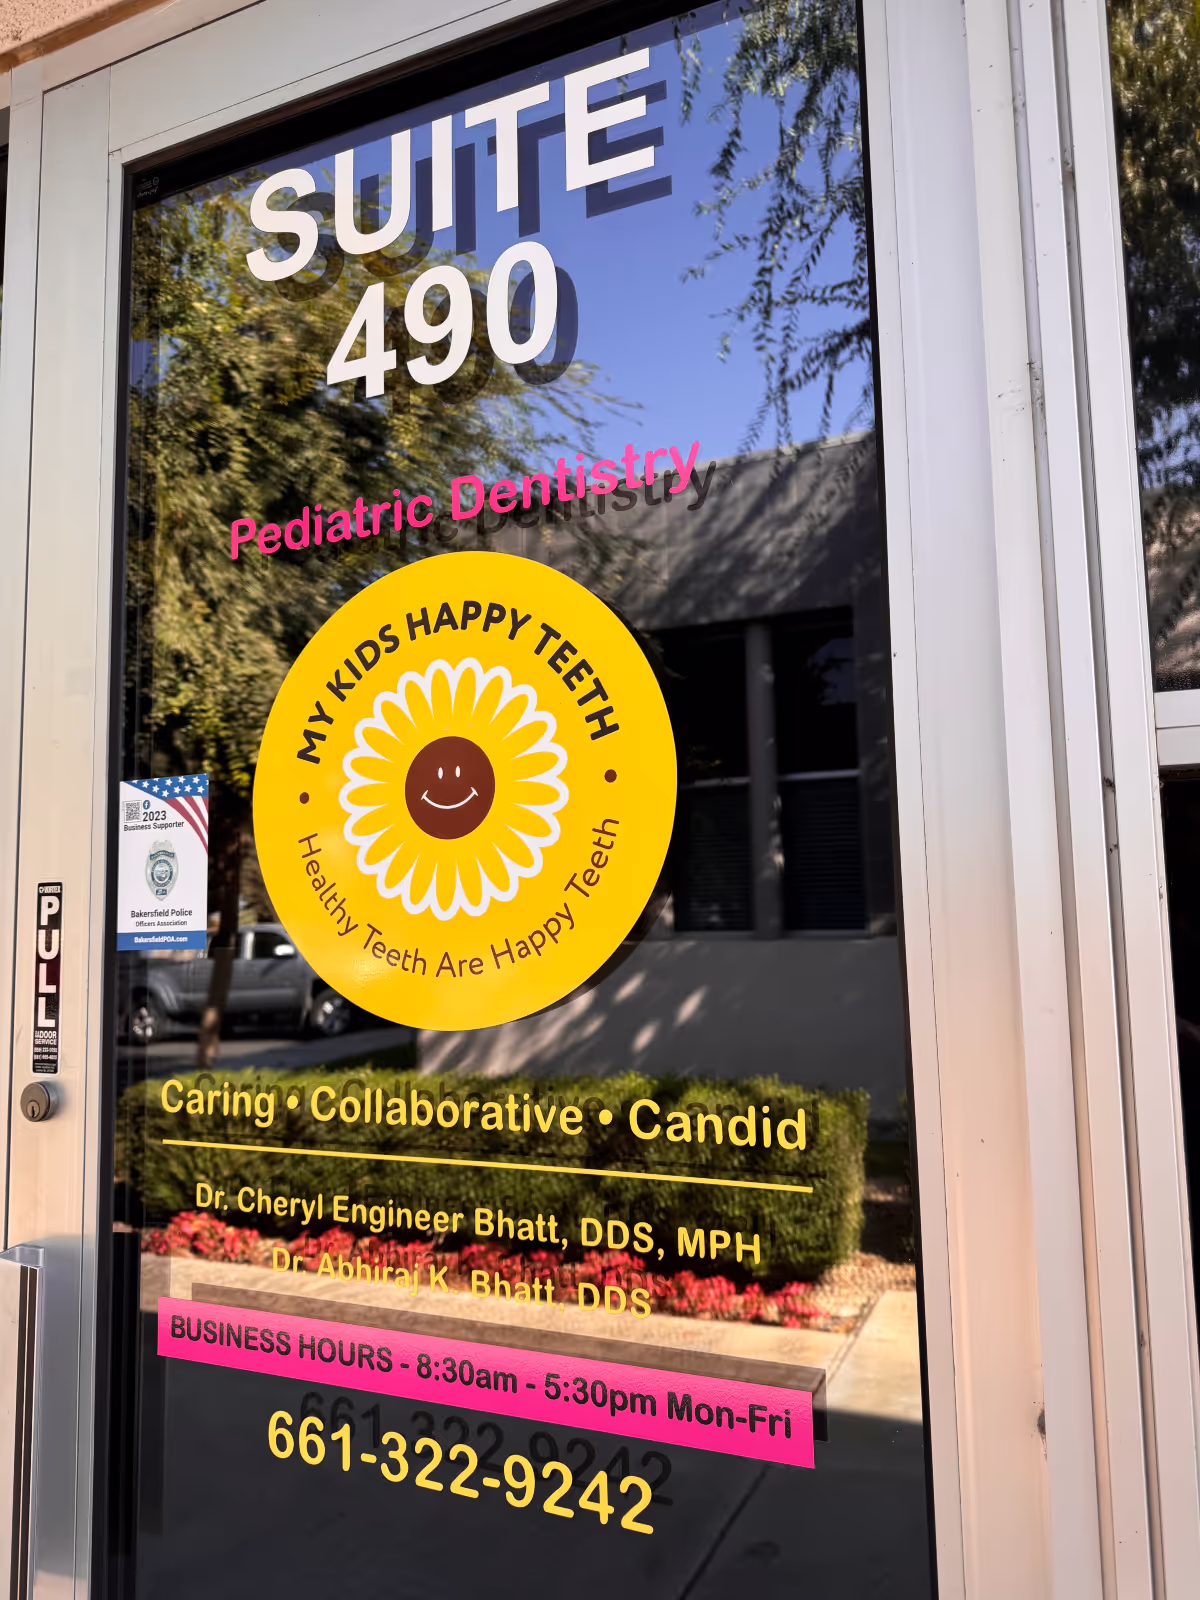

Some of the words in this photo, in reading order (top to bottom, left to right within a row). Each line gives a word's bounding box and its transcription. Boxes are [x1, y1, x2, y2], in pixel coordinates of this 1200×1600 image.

[246, 47, 654, 281] SUITE
[327, 241, 558, 398] 490
[230, 489, 433, 559] Pediatric
[451, 441, 700, 520] Dentistry
[297, 701, 334, 764] MY
[326, 624, 400, 702] KIDS
[406, 600, 532, 641] HAPPY
[533, 623, 619, 741] TEETH
[124, 823, 151, 831] Business
[153, 821, 184, 830] Supporter
[143, 811, 167, 821] 2023
[131, 909, 169, 918] Bakersfield
[171, 908, 193, 916] Police
[298, 833, 359, 937] Healthy
[364, 924, 427, 975] Teeth
[435, 951, 484, 978] Are
[490, 903, 575, 970] Happy
[564, 818, 619, 902] Teeth
[37, 896, 60, 1027] PULL
[40, 1031, 57, 1039] DOOR
[161, 1079, 275, 1128] Caring
[311, 1086, 583, 1135] Collaborative
[629, 1099, 806, 1150] Candid
[196, 1183, 228, 1211] Dr.
[237, 1187, 323, 1225] Cheryl
[333, 1195, 464, 1233] Engineer
[475, 1208, 568, 1249] Bhatt,
[581, 1217, 665, 1260] DDS,
[677, 1227, 760, 1264] MPH
[272, 1247, 306, 1276] Dr.
[317, 1252, 418, 1296] Abhiraj
[430, 1265, 458, 1295] K.
[471, 1269, 565, 1313] Bhatt,
[578, 1282, 651, 1319] DDS
[171, 1315, 291, 1356] BUSINESS
[299, 1334, 393, 1373] HOURS
[417, 1353, 517, 1393] 8:30am
[544, 1372, 656, 1416] 5:30pm
[667, 1391, 791, 1438] Mon-Fri
[268, 1411, 654, 1534] 661-322-9242
